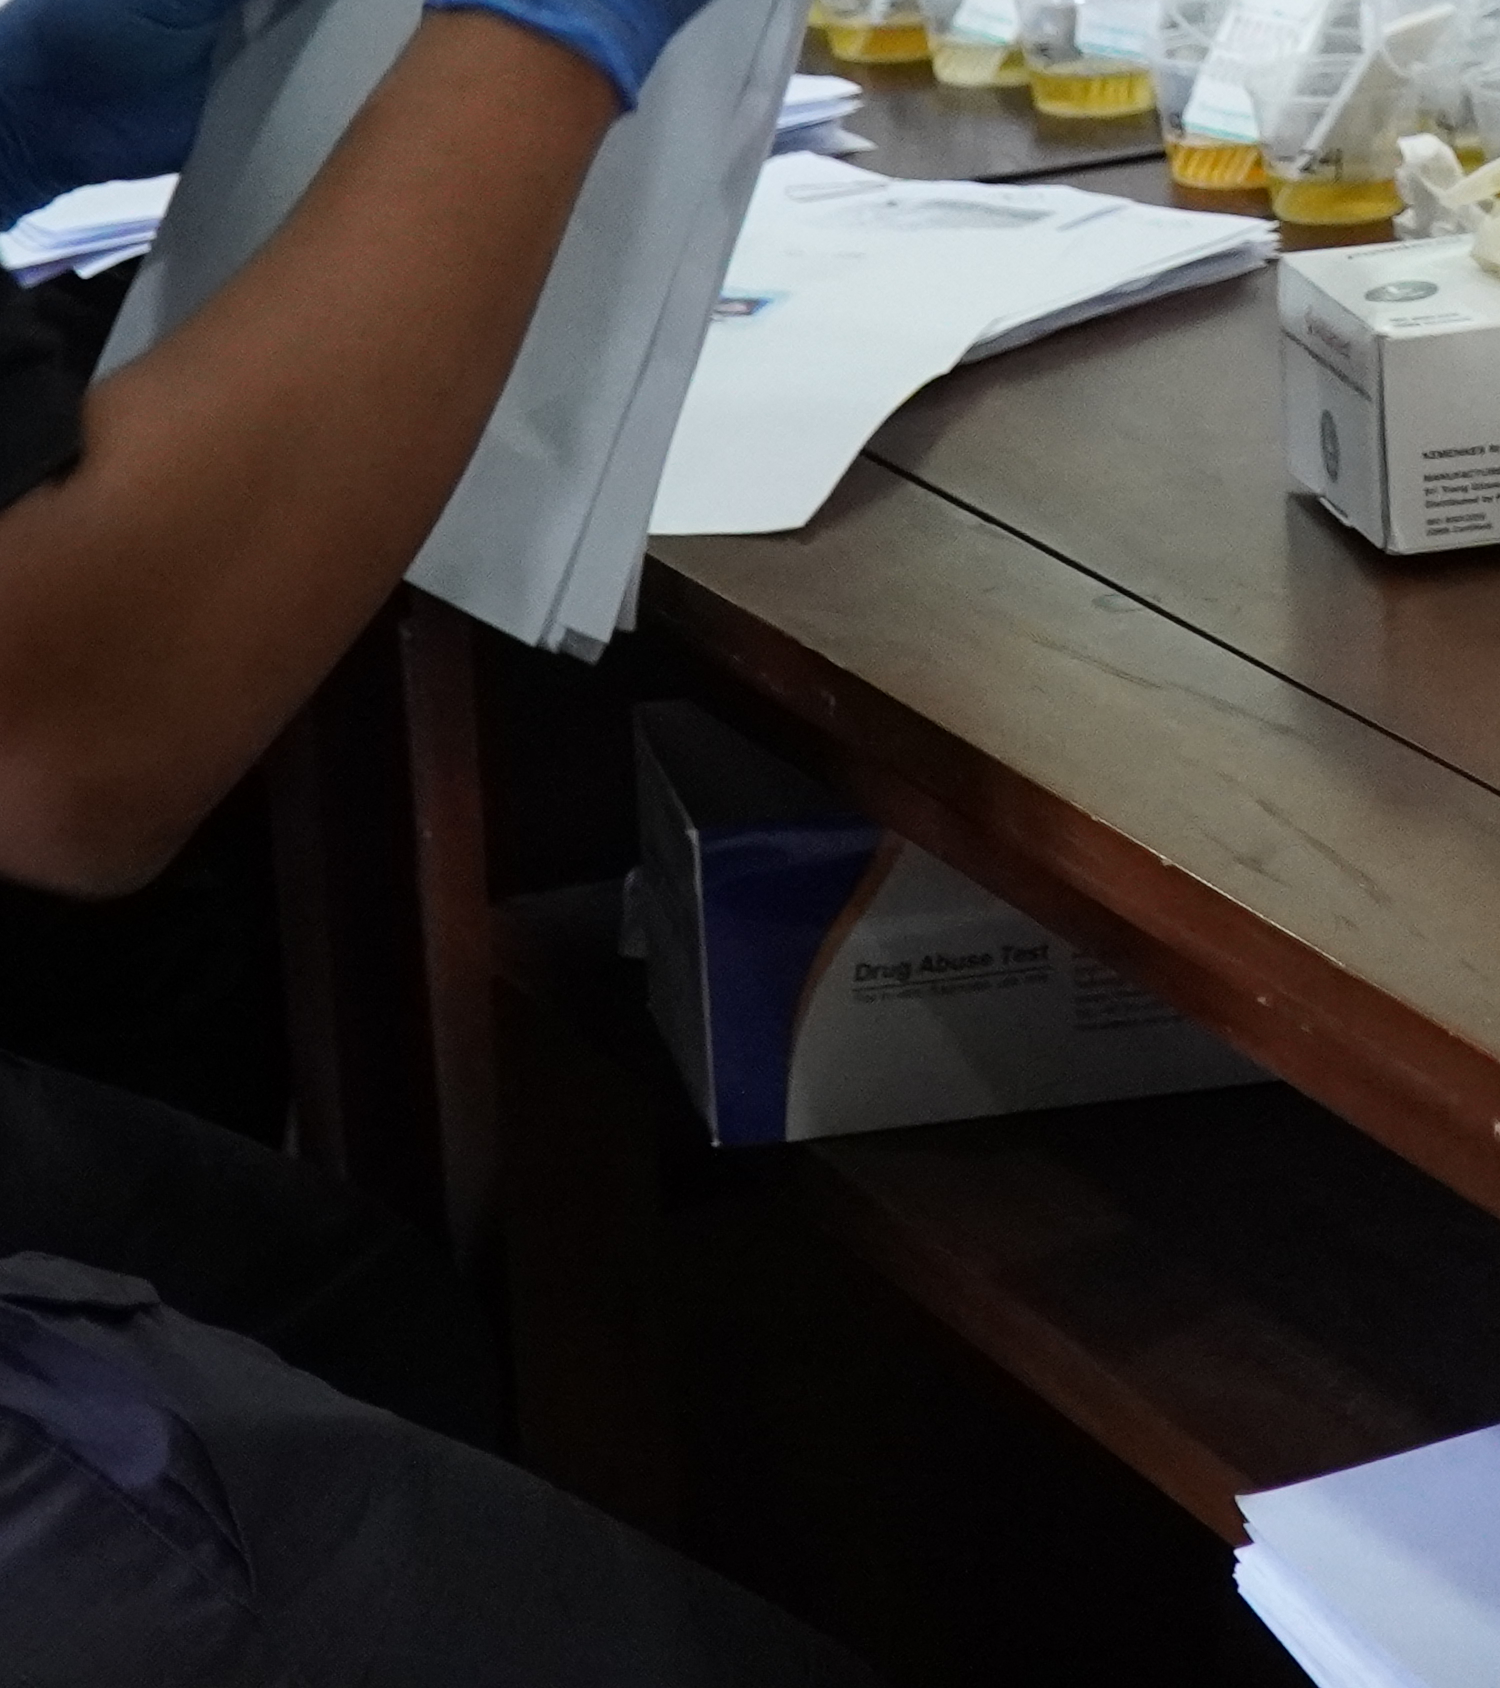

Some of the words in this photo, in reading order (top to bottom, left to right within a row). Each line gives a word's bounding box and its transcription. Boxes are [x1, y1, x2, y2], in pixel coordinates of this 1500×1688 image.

[854, 963, 912, 982] Drug
[921, 953, 996, 973] Abuse
[1002, 944, 1050, 962] Test
